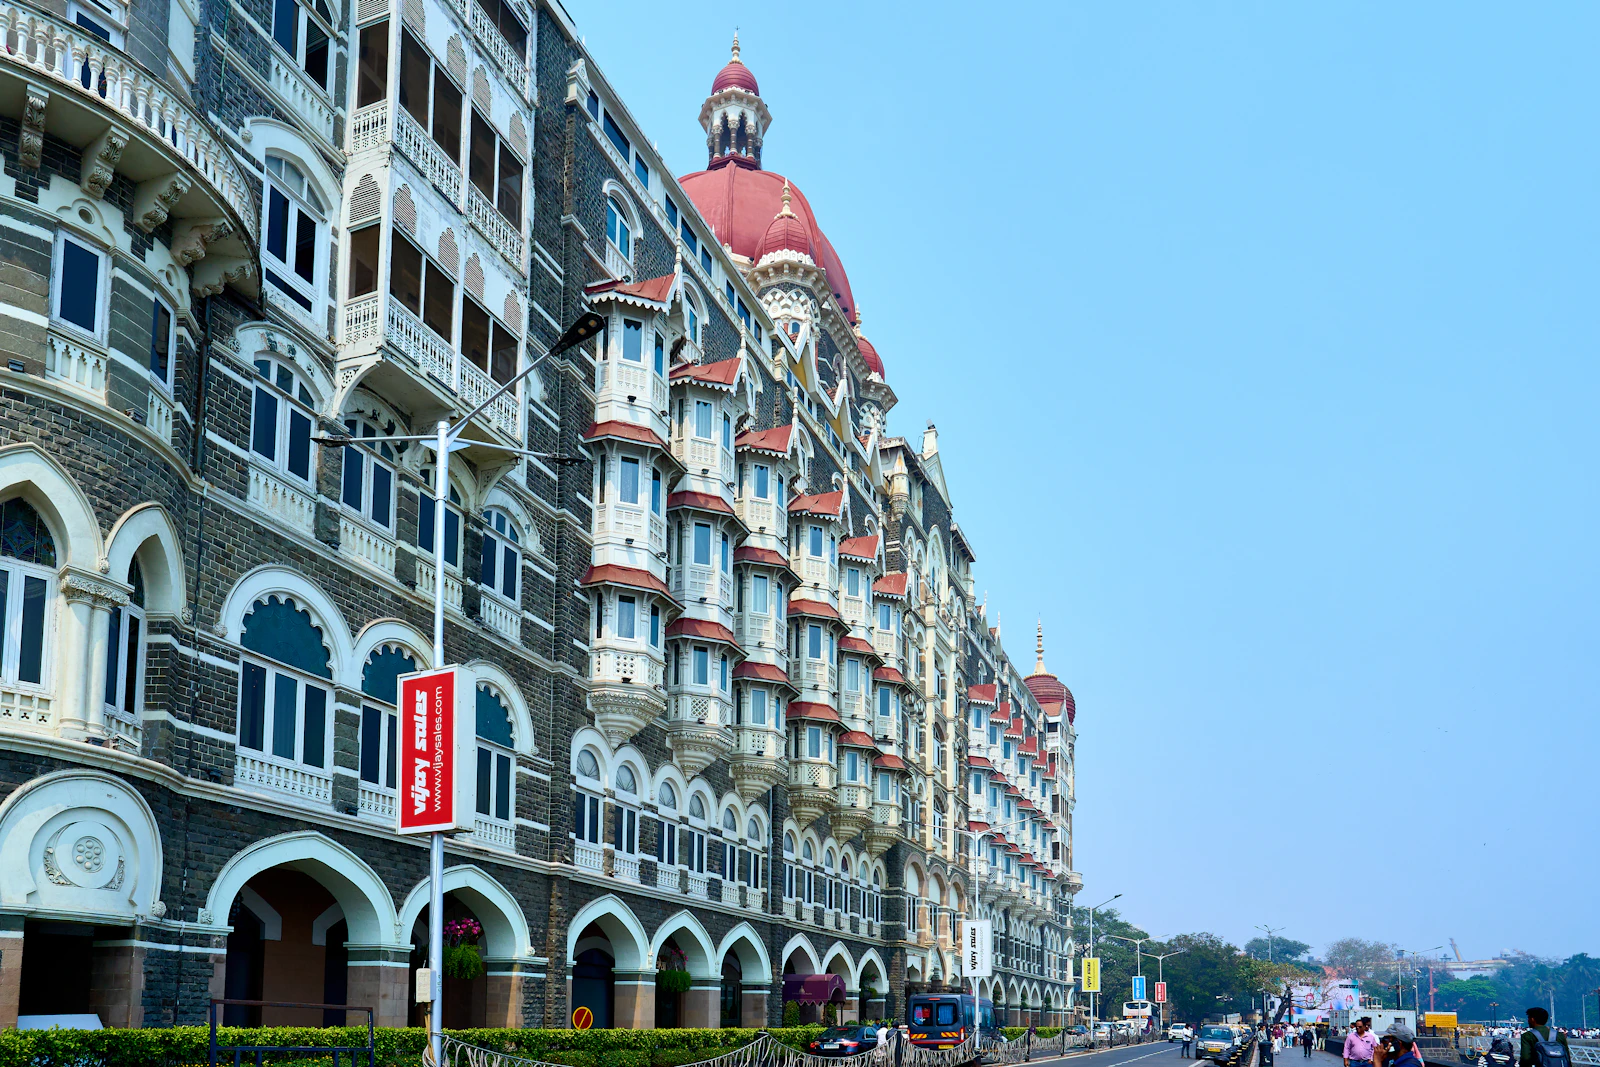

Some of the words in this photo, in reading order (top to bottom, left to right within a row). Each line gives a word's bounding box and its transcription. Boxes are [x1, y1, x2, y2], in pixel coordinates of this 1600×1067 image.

[413, 689, 428, 752] sales
[432, 686, 444, 812] www.vijaysales.com
[411, 757, 430, 815] vijay
[969, 951, 978, 970] vijay
